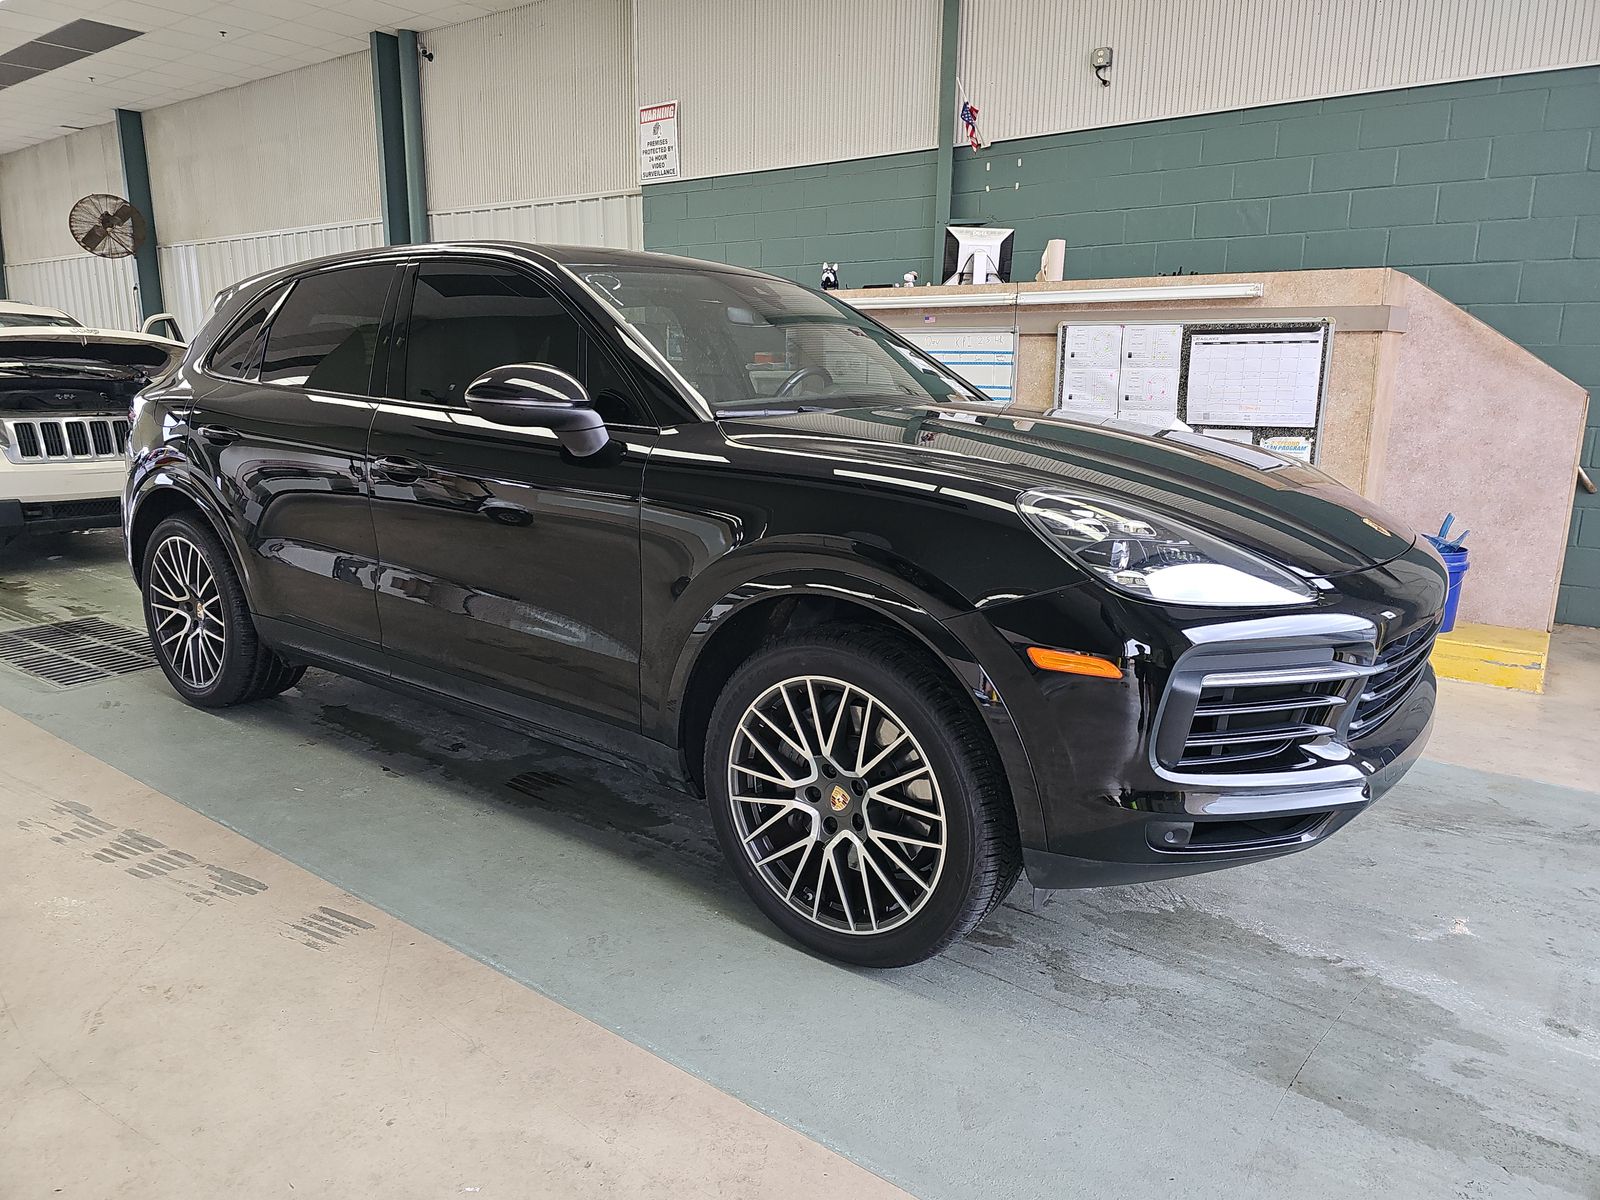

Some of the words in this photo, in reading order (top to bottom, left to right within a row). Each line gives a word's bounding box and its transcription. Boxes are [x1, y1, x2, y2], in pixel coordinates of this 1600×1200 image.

[641, 105, 675, 122] WARNING
[647, 139, 668, 148] PREMISES
[642, 147, 667, 155] PROTECTED
[642, 168, 675, 178] SURVEILLANCE
